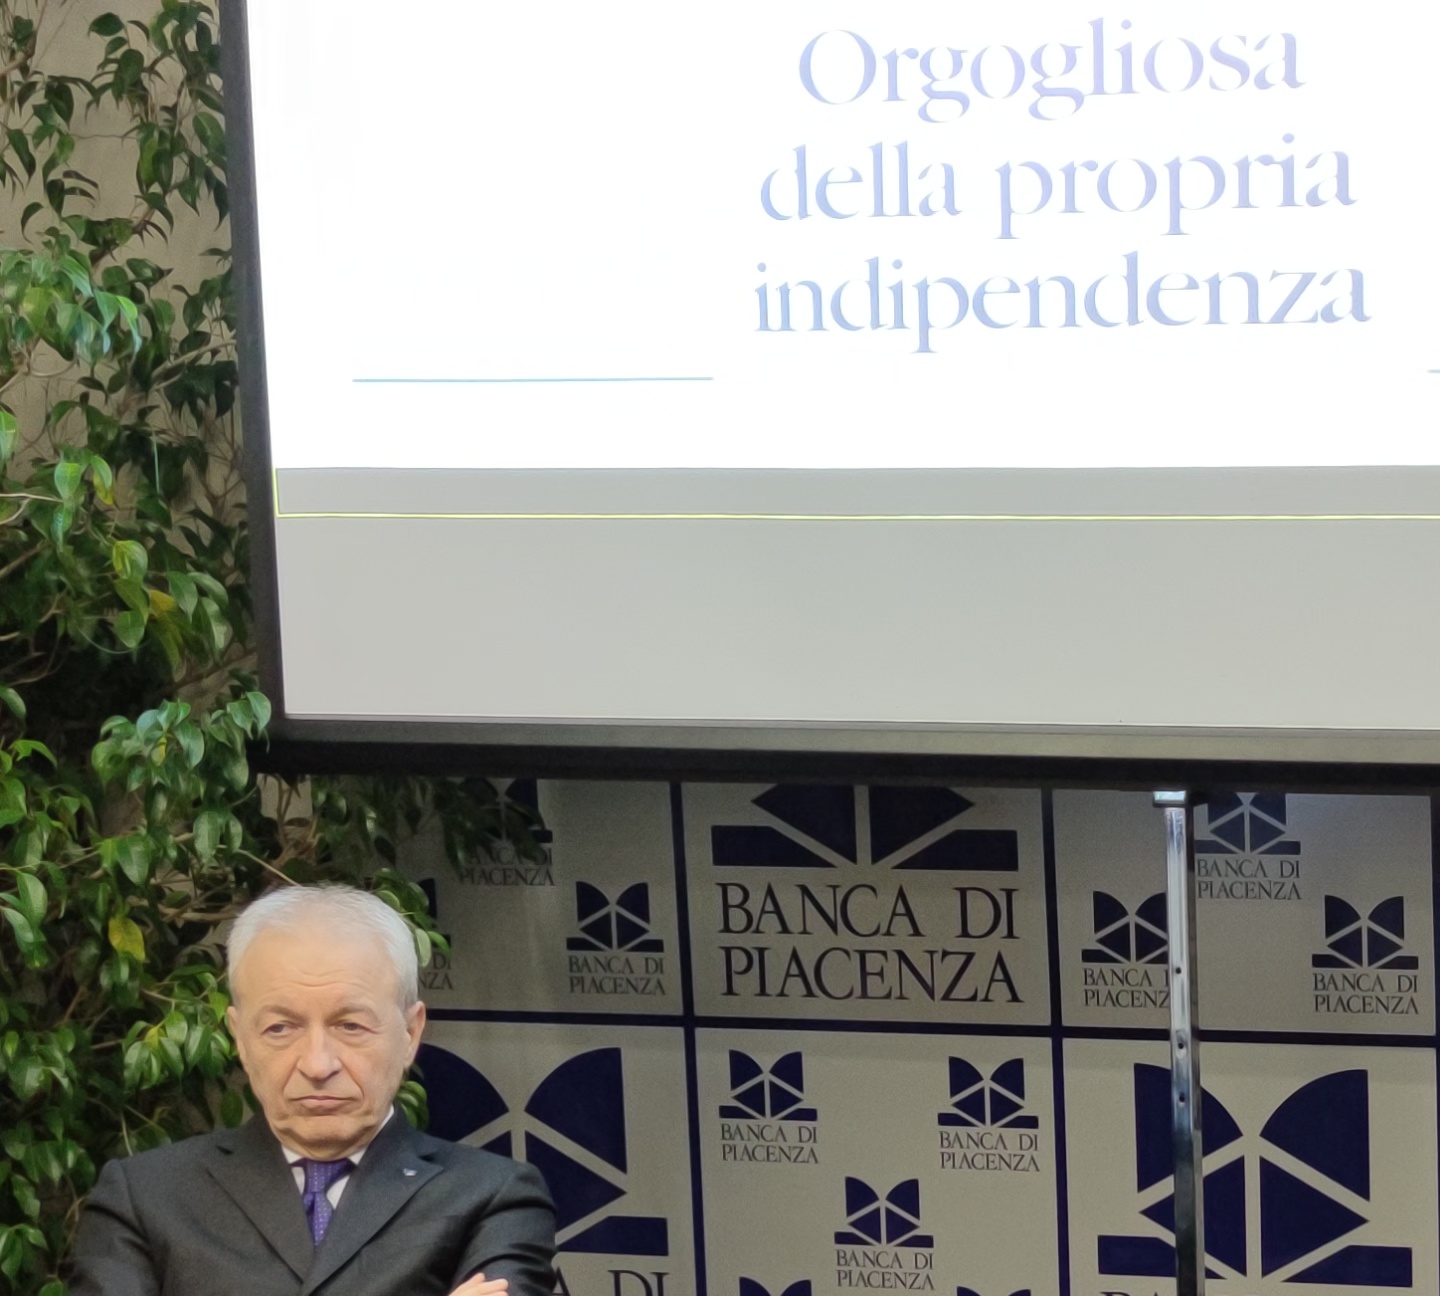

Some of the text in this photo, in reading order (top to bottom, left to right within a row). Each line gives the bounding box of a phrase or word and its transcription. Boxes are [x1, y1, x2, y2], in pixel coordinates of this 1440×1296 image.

[796, 19, 1304, 125] Orgogliosa
[757, 131, 1358, 241] della propria
[752, 250, 1374, 355] indipendenza
[1197, 858, 1301, 881] BANCA DI
[1197, 879, 1302, 901] PIACENZA
[716, 882, 1019, 941] BANCA DI
[568, 956, 664, 974] BANCA DI
[721, 946, 1024, 1004] PIACENZA
[569, 976, 666, 996] PIACENZA
[1083, 967, 1152, 987] BANCA
[1313, 971, 1419, 994] BANCA DI
[1083, 989, 1170, 1008] PIACENZ
[1313, 992, 1419, 1015] PIACENZA
[720, 1123, 819, 1145] BANCA DI
[938, 1131, 1039, 1152] BANCA DI
[721, 1143, 819, 1164] PIACENZA
[939, 1150, 1040, 1172] PIACENZA
[836, 1248, 934, 1270] BANCA DI
[836, 1269, 934, 1291] PIACENZA
